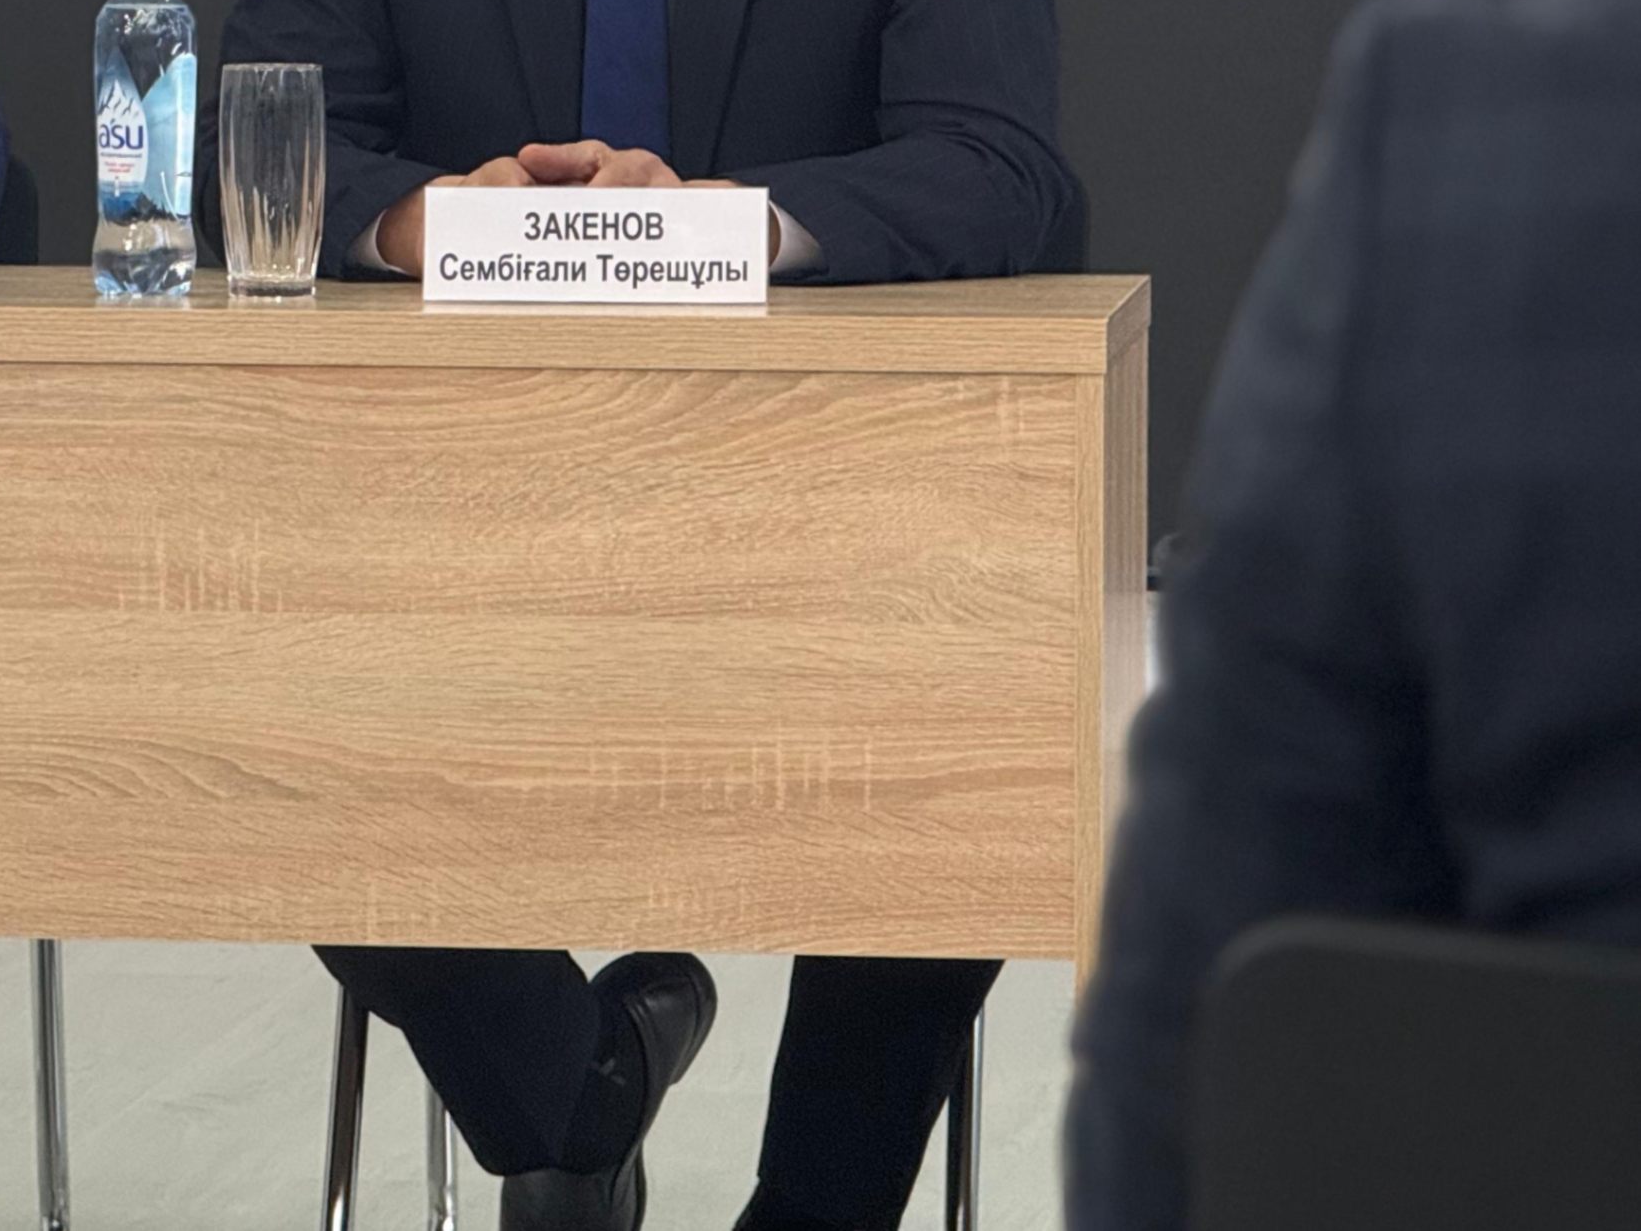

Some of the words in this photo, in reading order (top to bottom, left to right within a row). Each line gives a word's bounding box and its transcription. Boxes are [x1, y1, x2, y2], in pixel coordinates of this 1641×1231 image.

[524, 212, 665, 242] ЗАКЕНОВ
[439, 253, 587, 283] Сембіғали
[596, 254, 749, 290] Төрешұлы
